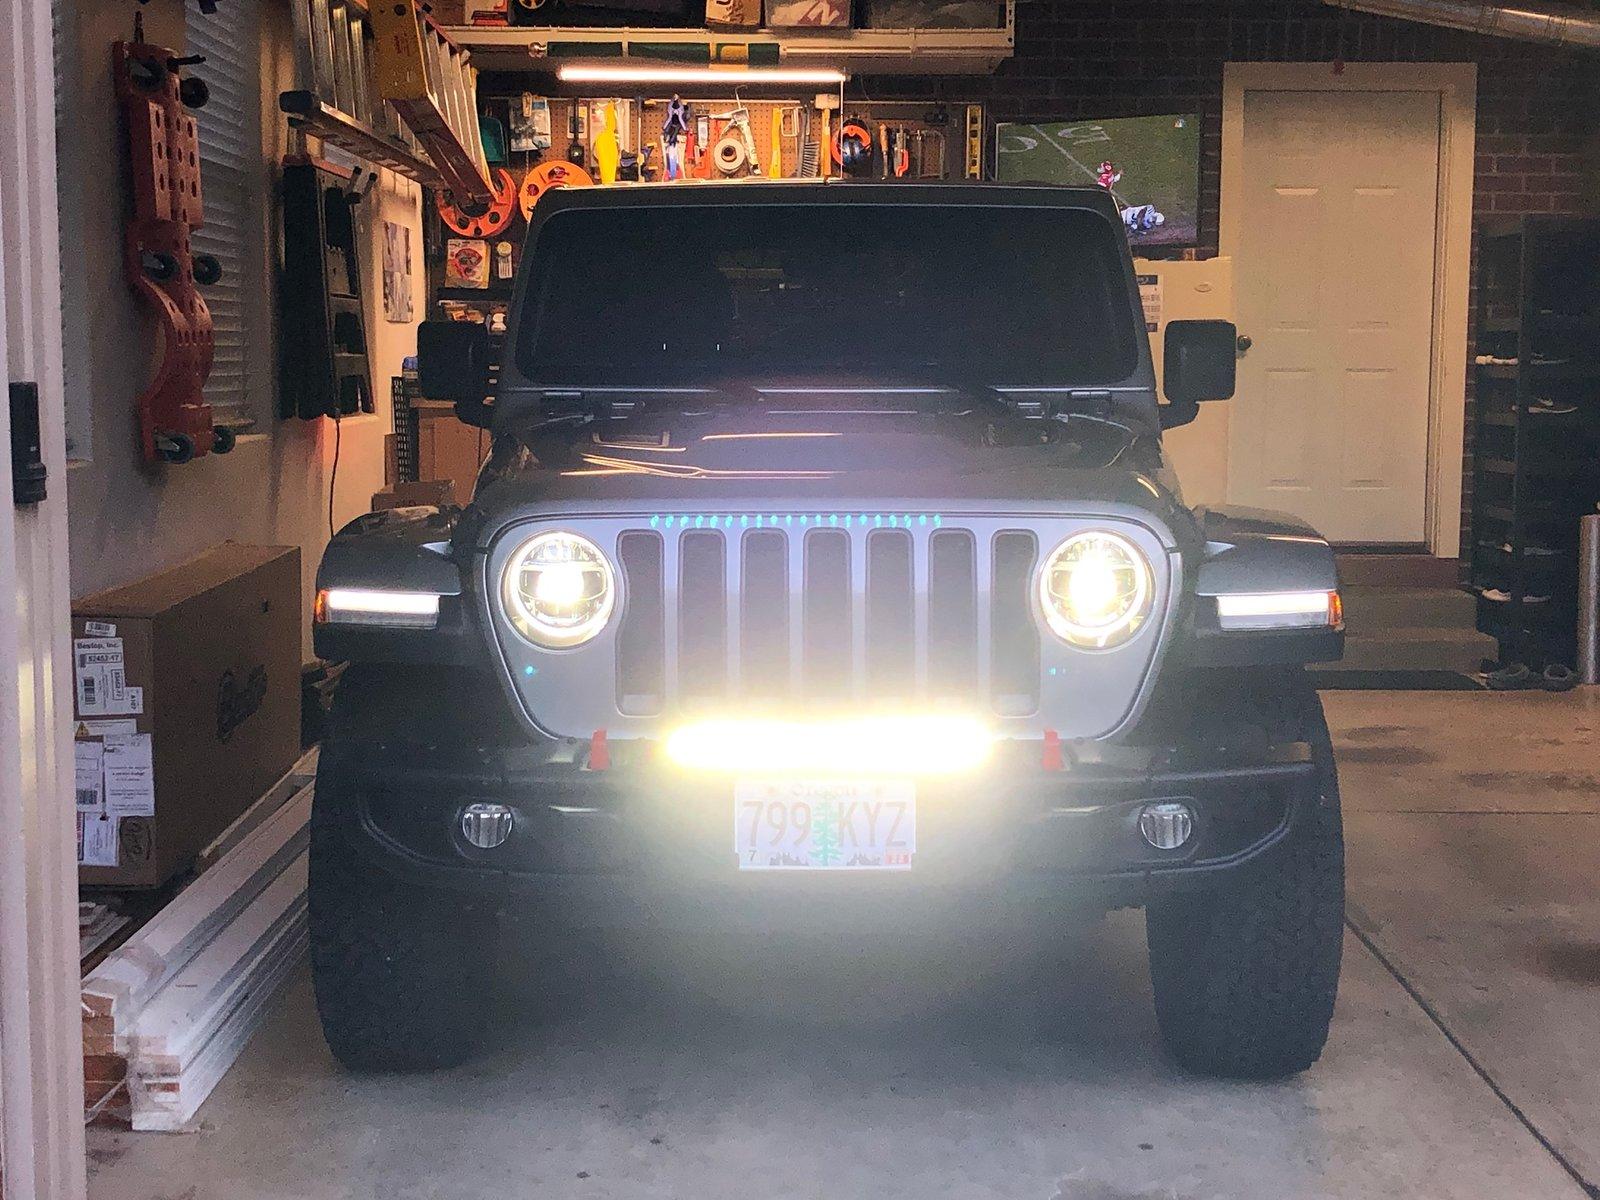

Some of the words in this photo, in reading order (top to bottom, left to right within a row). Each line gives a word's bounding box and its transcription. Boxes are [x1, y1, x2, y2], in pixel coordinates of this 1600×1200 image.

[742, 800, 812, 847] 799
[837, 800, 908, 847] KYZ
[748, 849, 758, 861] 7
